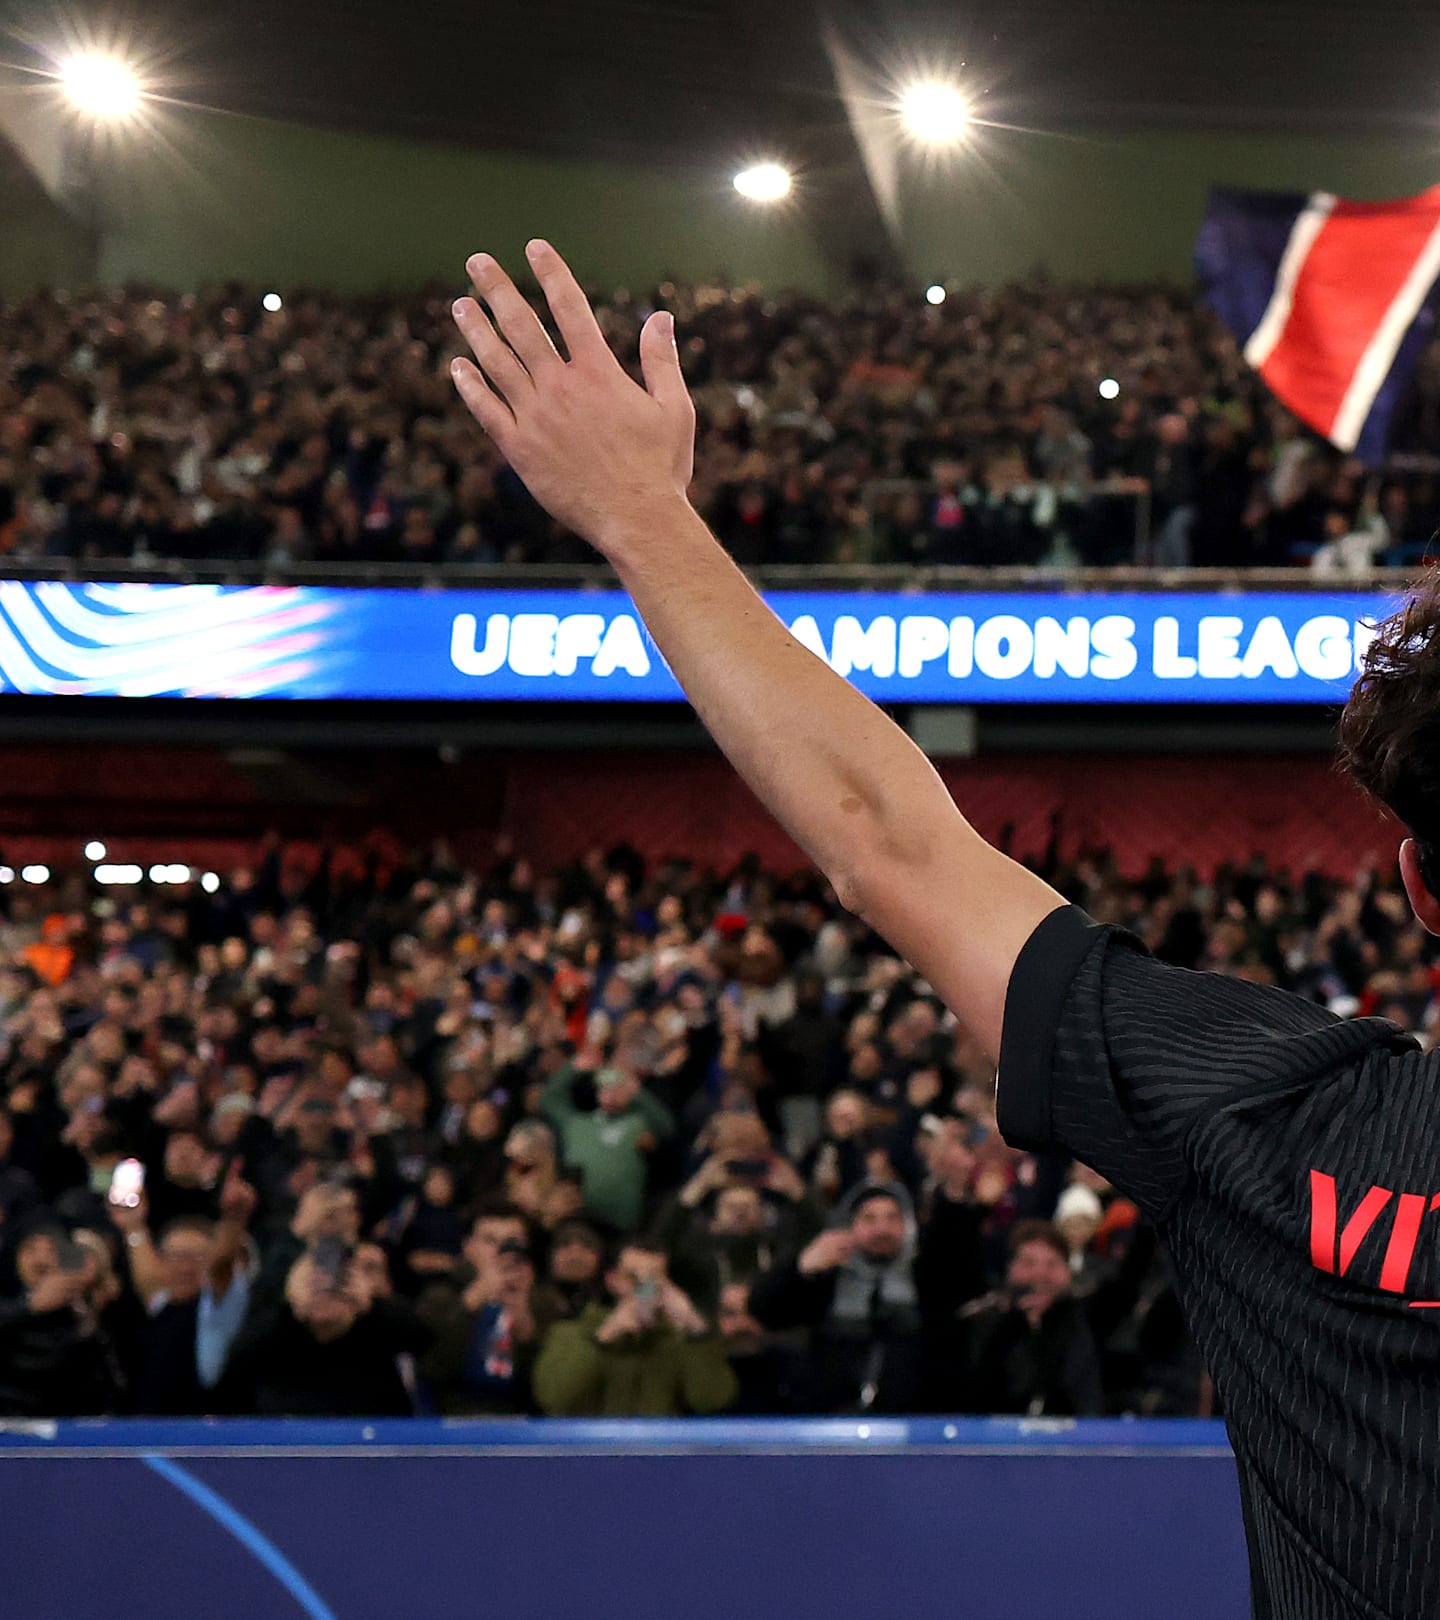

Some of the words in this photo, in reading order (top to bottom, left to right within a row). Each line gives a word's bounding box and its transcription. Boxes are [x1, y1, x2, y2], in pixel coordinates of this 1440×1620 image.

[451, 614, 649, 676] UEFA
[792, 616, 1137, 681] AMPIONS
[1154, 616, 1380, 679] LEAG
